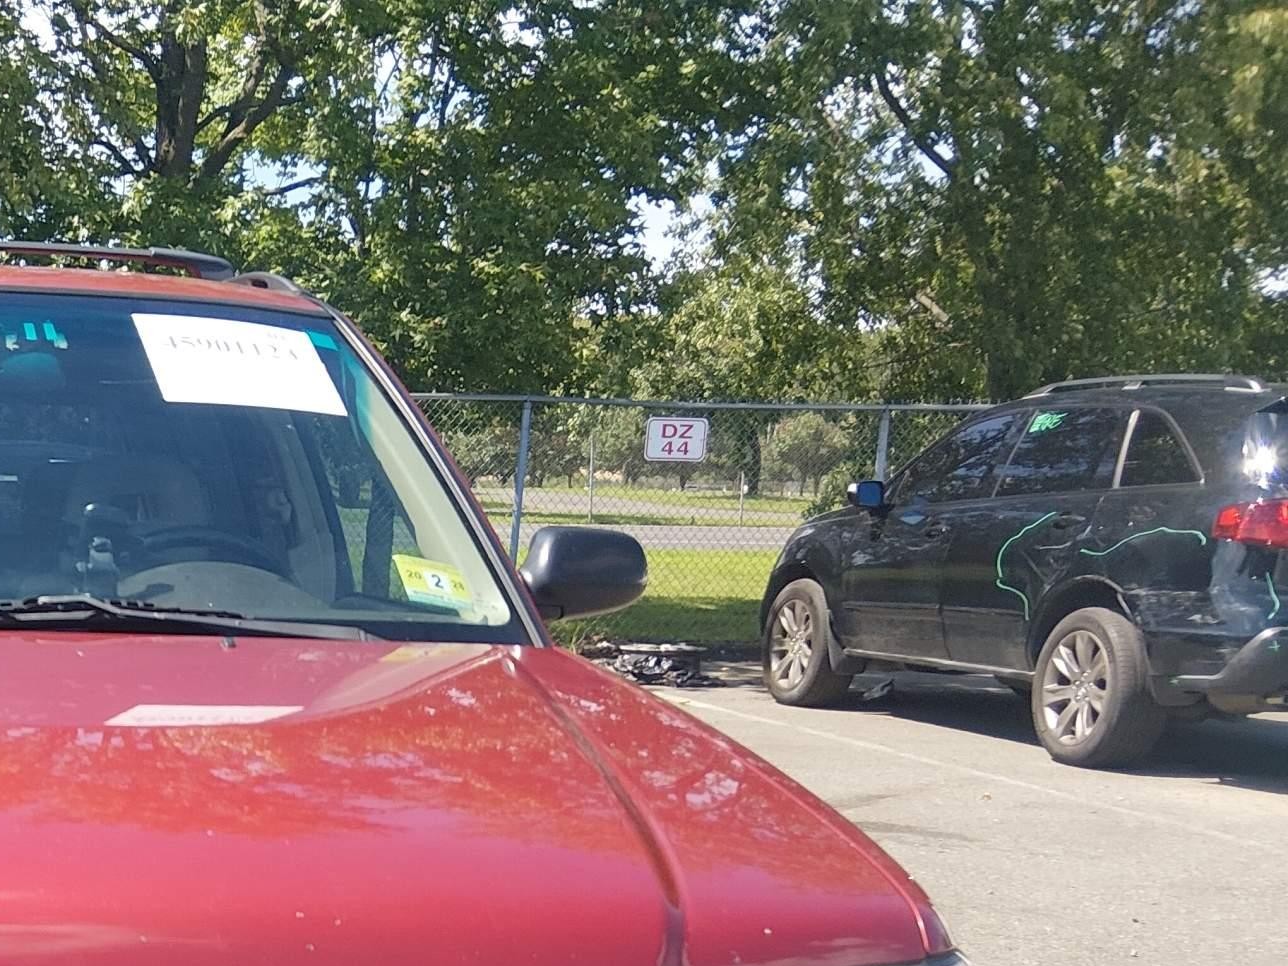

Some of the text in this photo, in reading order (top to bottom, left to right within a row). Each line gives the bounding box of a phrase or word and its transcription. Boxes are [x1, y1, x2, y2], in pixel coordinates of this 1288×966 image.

[660, 423, 694, 439] DZ
[660, 441, 690, 456] 44
[431, 574, 444, 589] 2
